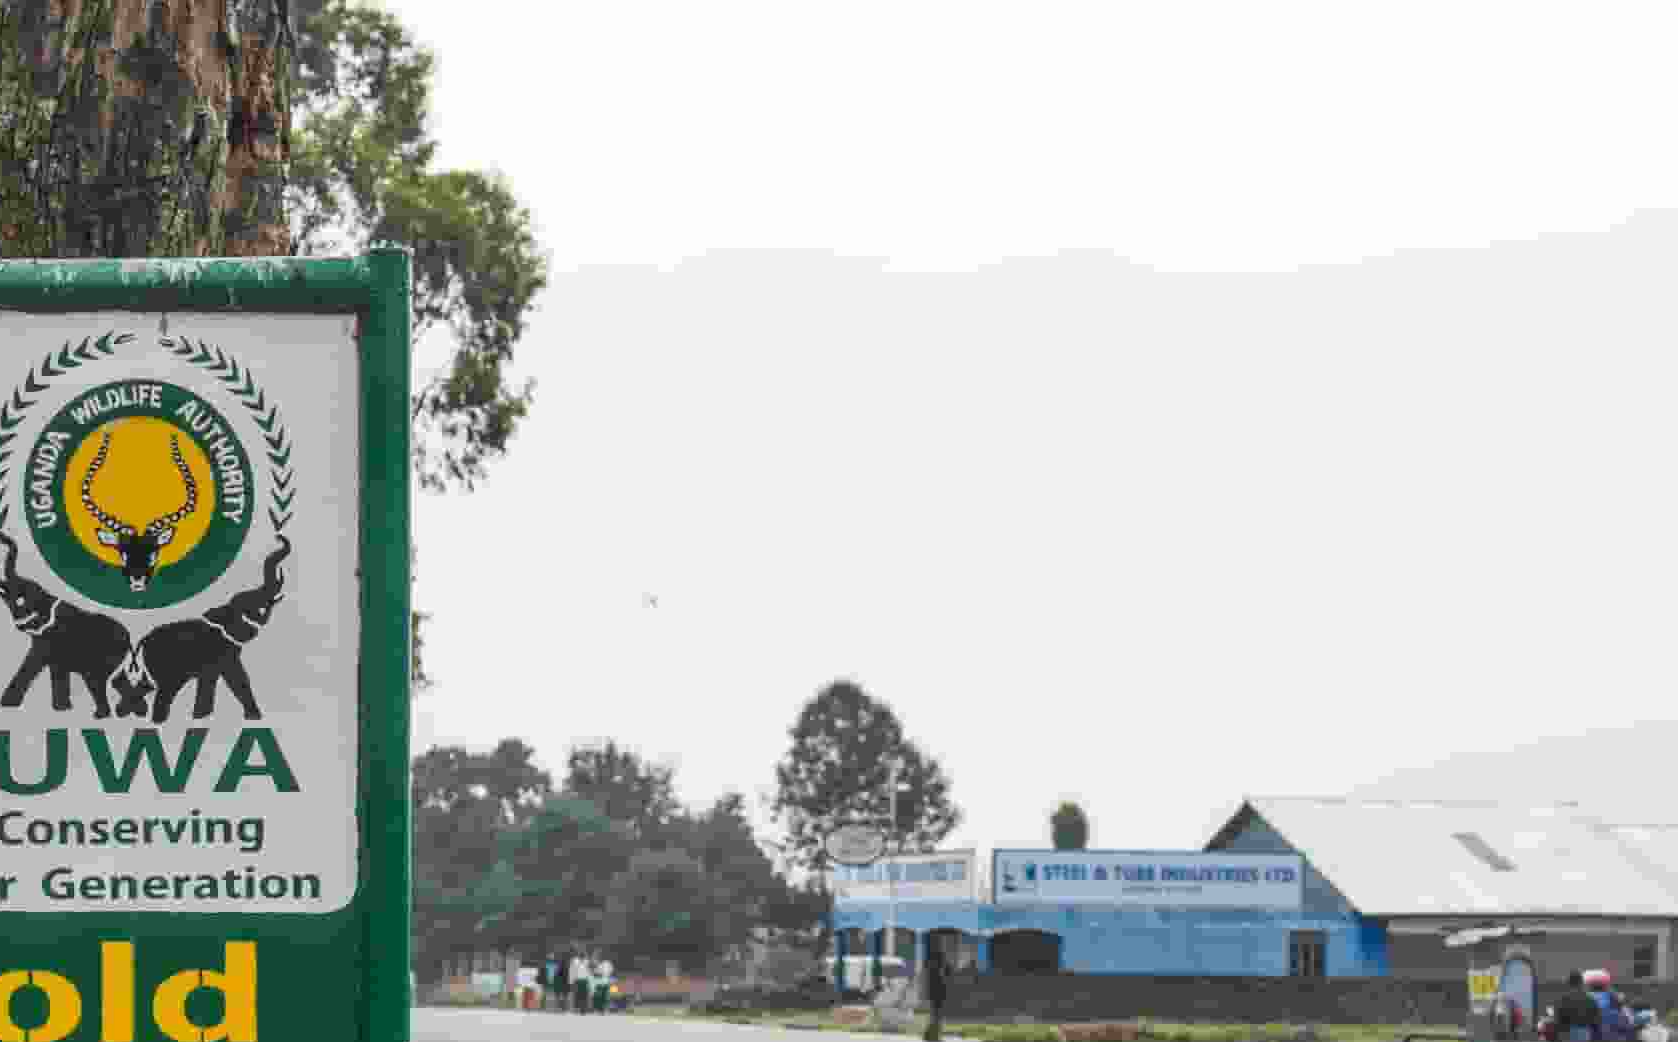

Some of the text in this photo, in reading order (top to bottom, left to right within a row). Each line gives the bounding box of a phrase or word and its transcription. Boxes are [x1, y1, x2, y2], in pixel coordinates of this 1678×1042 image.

[30, 384, 244, 528] UGANDA WILDLIFE AUTHORITY
[40, 866, 322, 902] Generation
